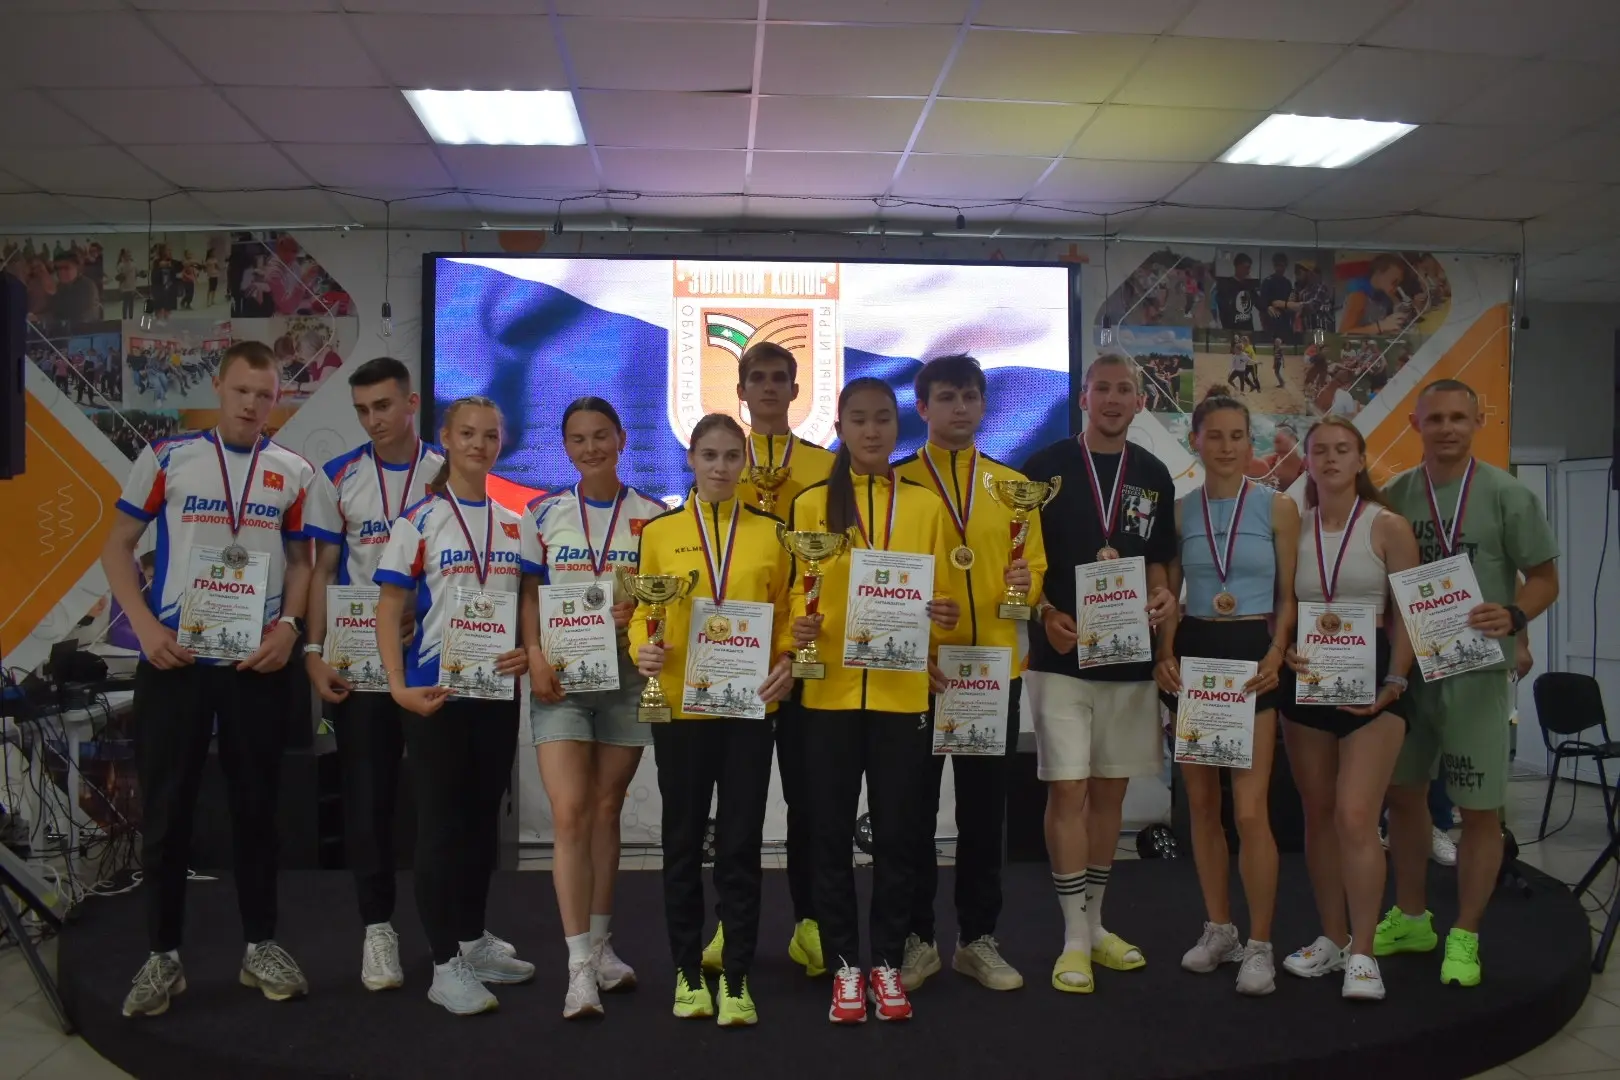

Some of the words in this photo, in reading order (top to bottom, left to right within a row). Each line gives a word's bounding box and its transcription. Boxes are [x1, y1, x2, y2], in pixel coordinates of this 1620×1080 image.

[193, 578, 256, 595] ГРАМОТА
[858, 584, 922, 600] ГРАМОТА
[1083, 589, 1137, 606] ГРАМОТА
[1408, 589, 1472, 615] ГРАМОТА
[335, 617, 377, 628] ГРАМО
[450, 618, 506, 634] ГРАМОТА
[549, 614, 605, 628] ГРАМОТА
[1305, 634, 1366, 646] ГРАМОТА
[1187, 689, 1246, 703] ГРАМОТА
